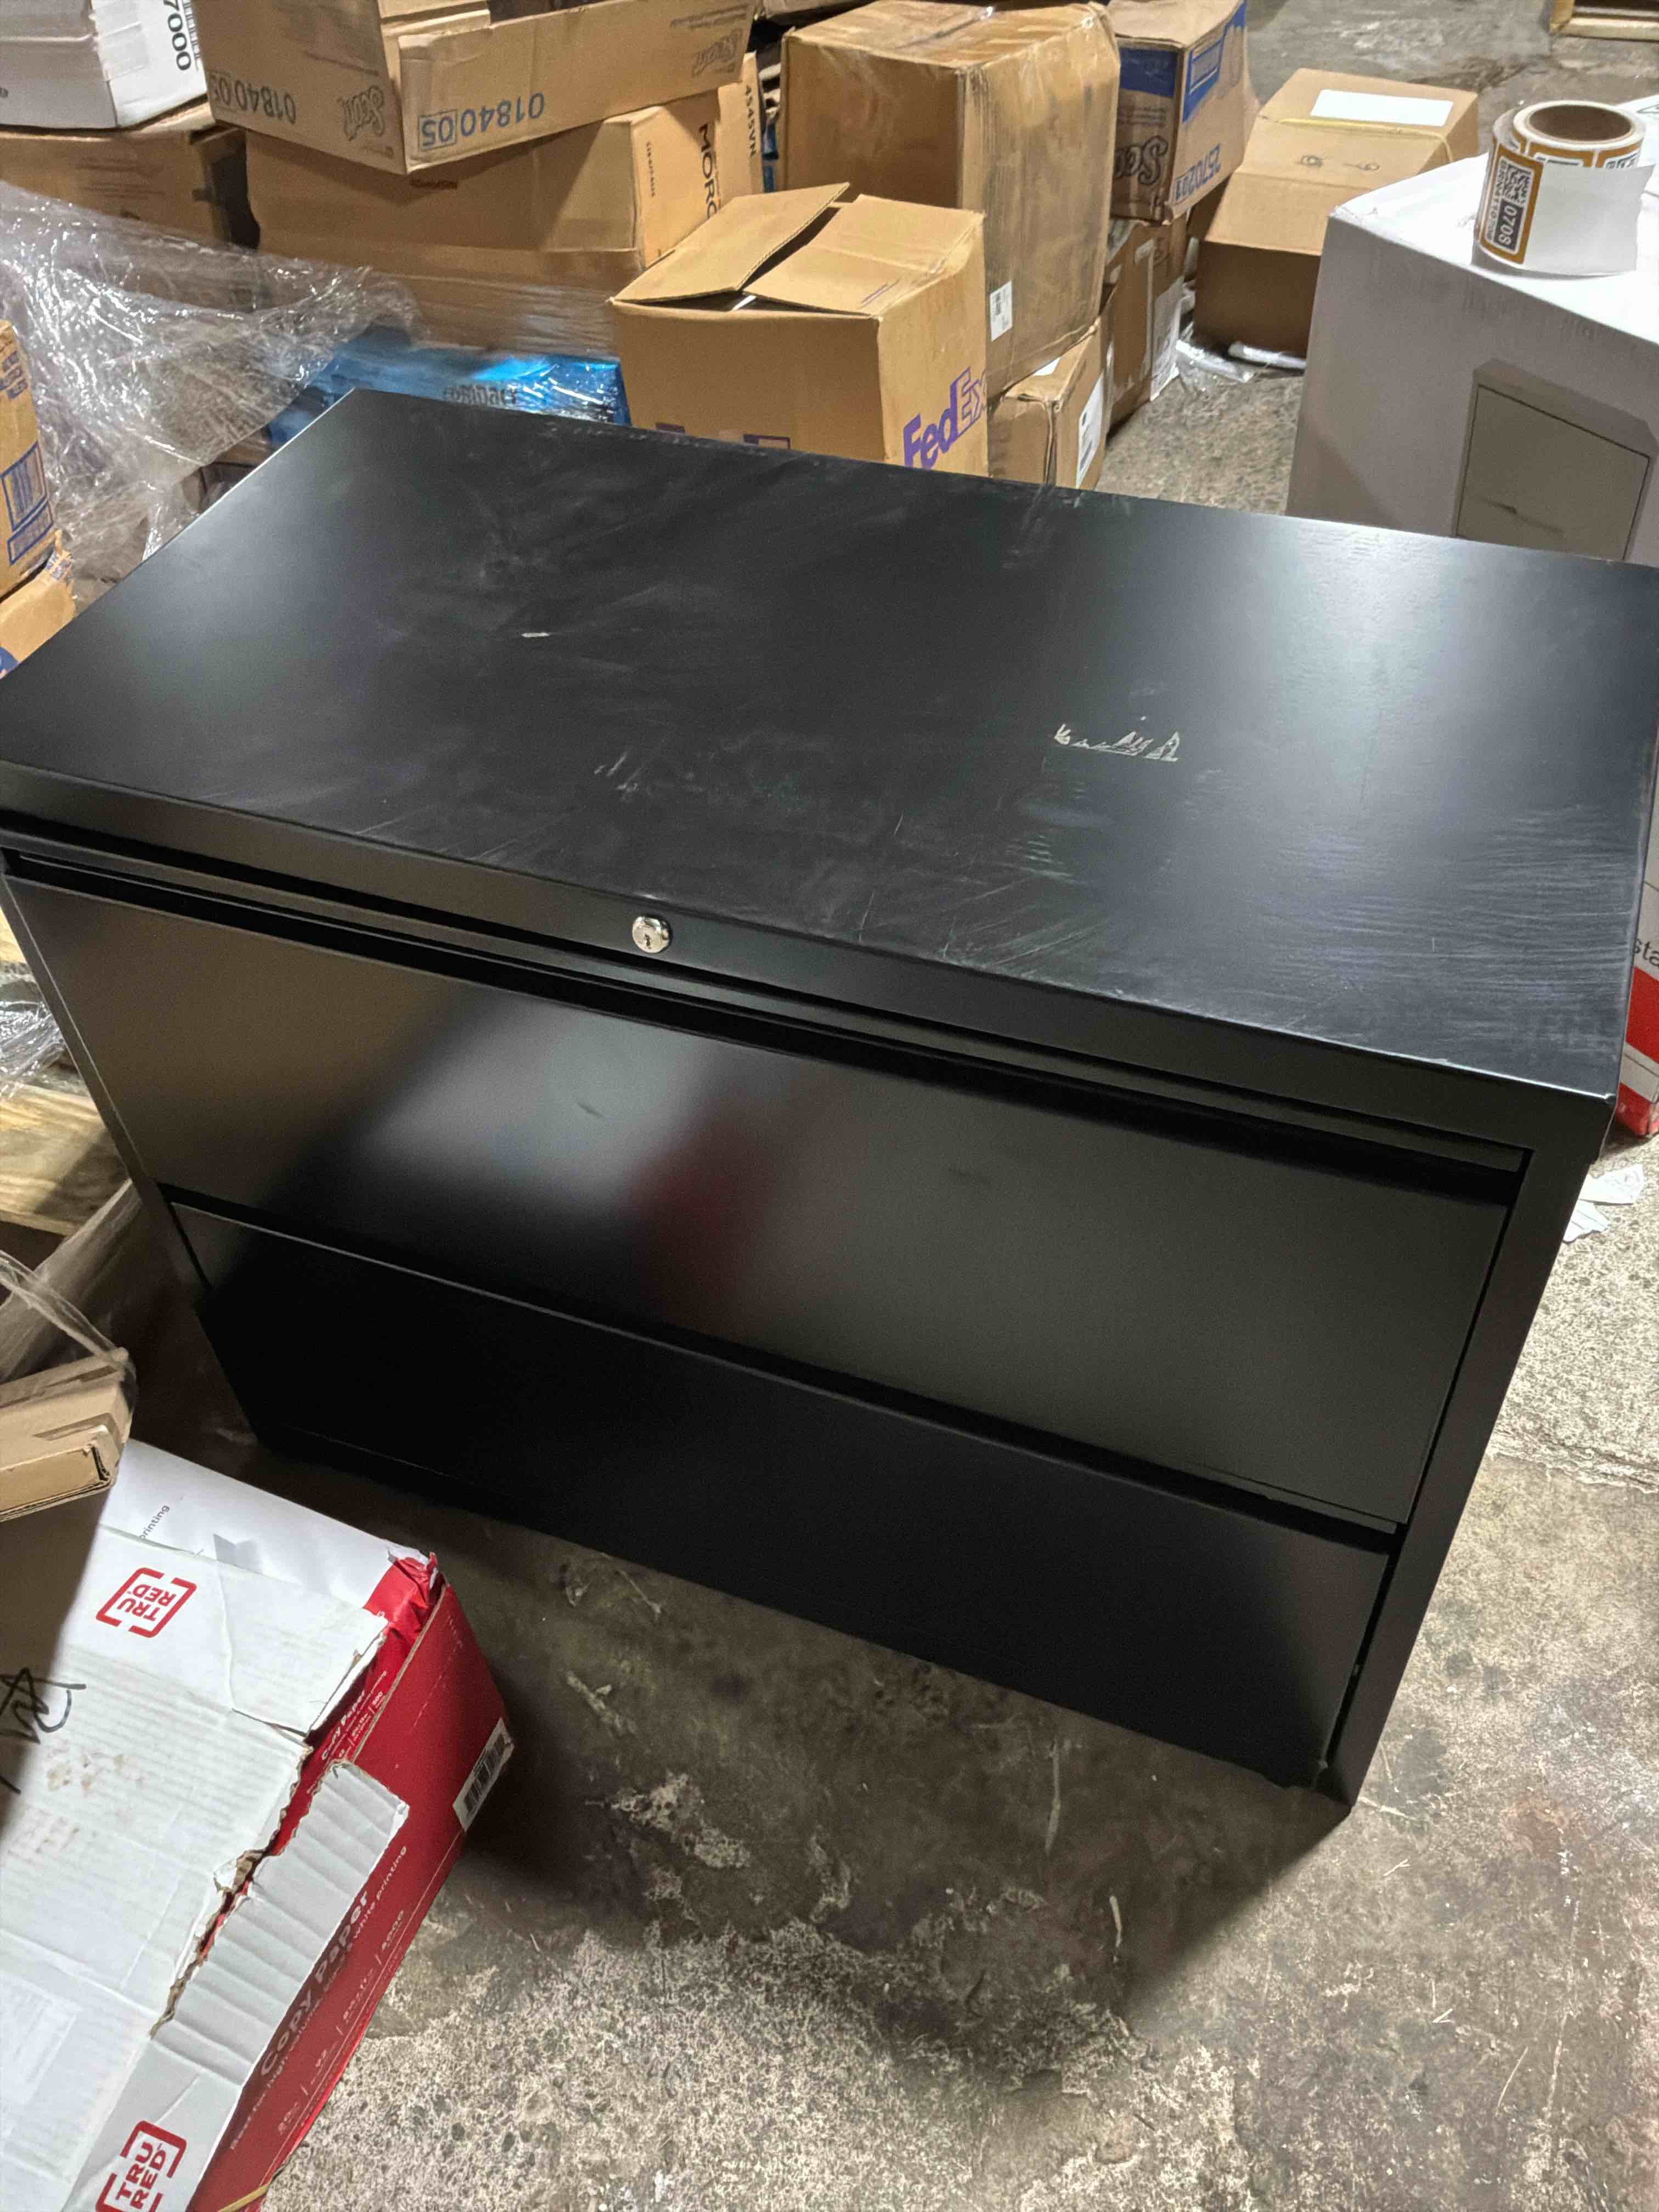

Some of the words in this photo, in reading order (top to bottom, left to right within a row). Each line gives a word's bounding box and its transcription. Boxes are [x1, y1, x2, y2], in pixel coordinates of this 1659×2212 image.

[116, 1598, 161, 1621] TRU
[133, 1583, 176, 1606] RED
[375, 1846, 407, 1901] printing
[314, 1891, 367, 1984] Paper
[261, 1989, 312, 2075] Copy
[115, 2142, 153, 2200] TRU
[131, 2149, 166, 2210] RED
